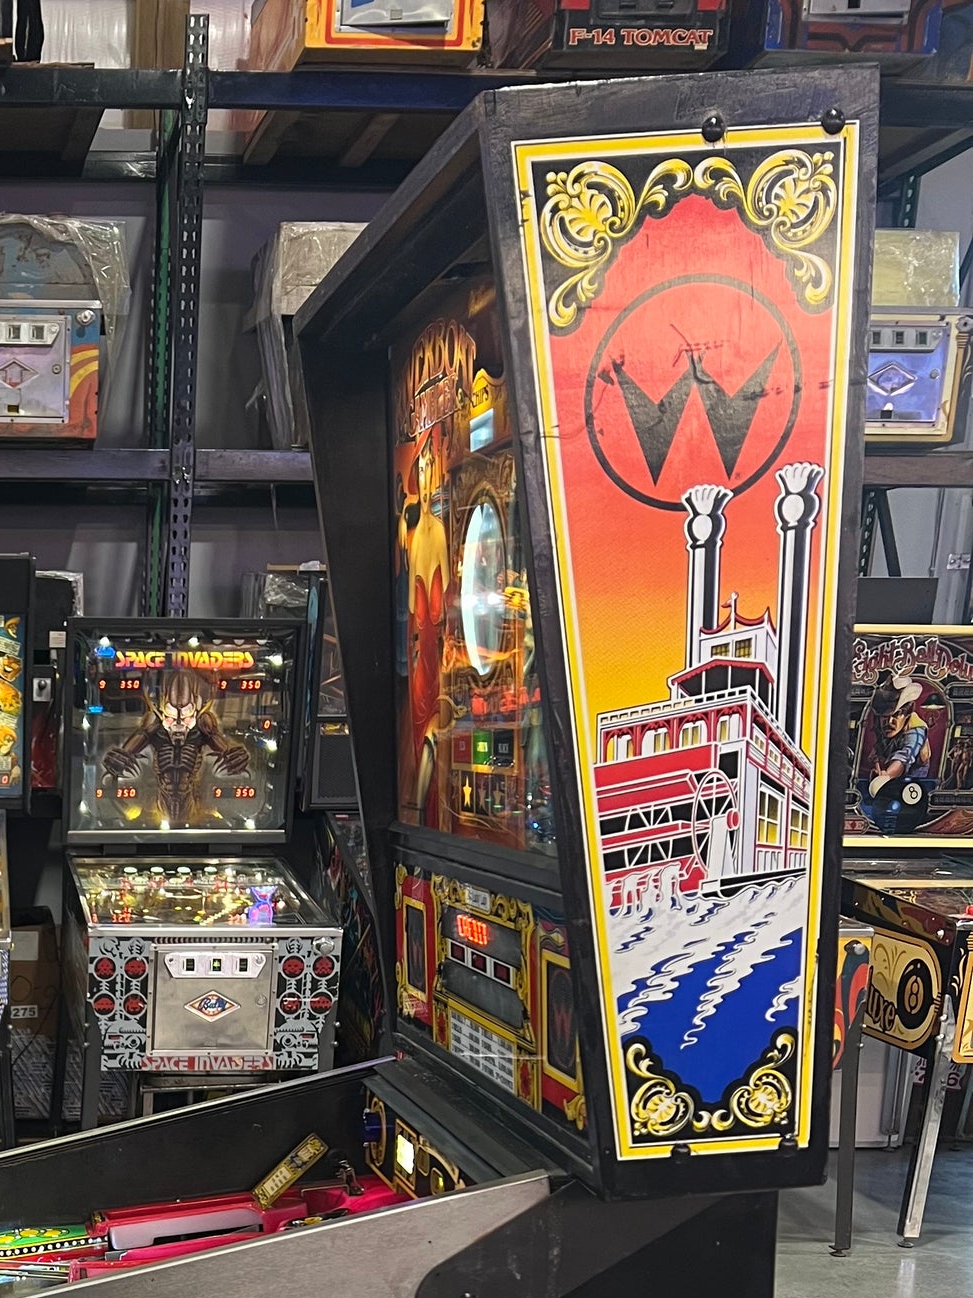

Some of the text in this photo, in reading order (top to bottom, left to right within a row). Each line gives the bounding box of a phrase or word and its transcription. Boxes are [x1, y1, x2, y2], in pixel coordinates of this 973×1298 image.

[568, 28, 714, 46] F-14 TOMCAT
[115, 651, 255, 669] SPACE INVADERS
[908, 785, 919, 800] 8
[12, 1007, 37, 1018] 275
[141, 1056, 275, 1071] SPACE INVADERS
